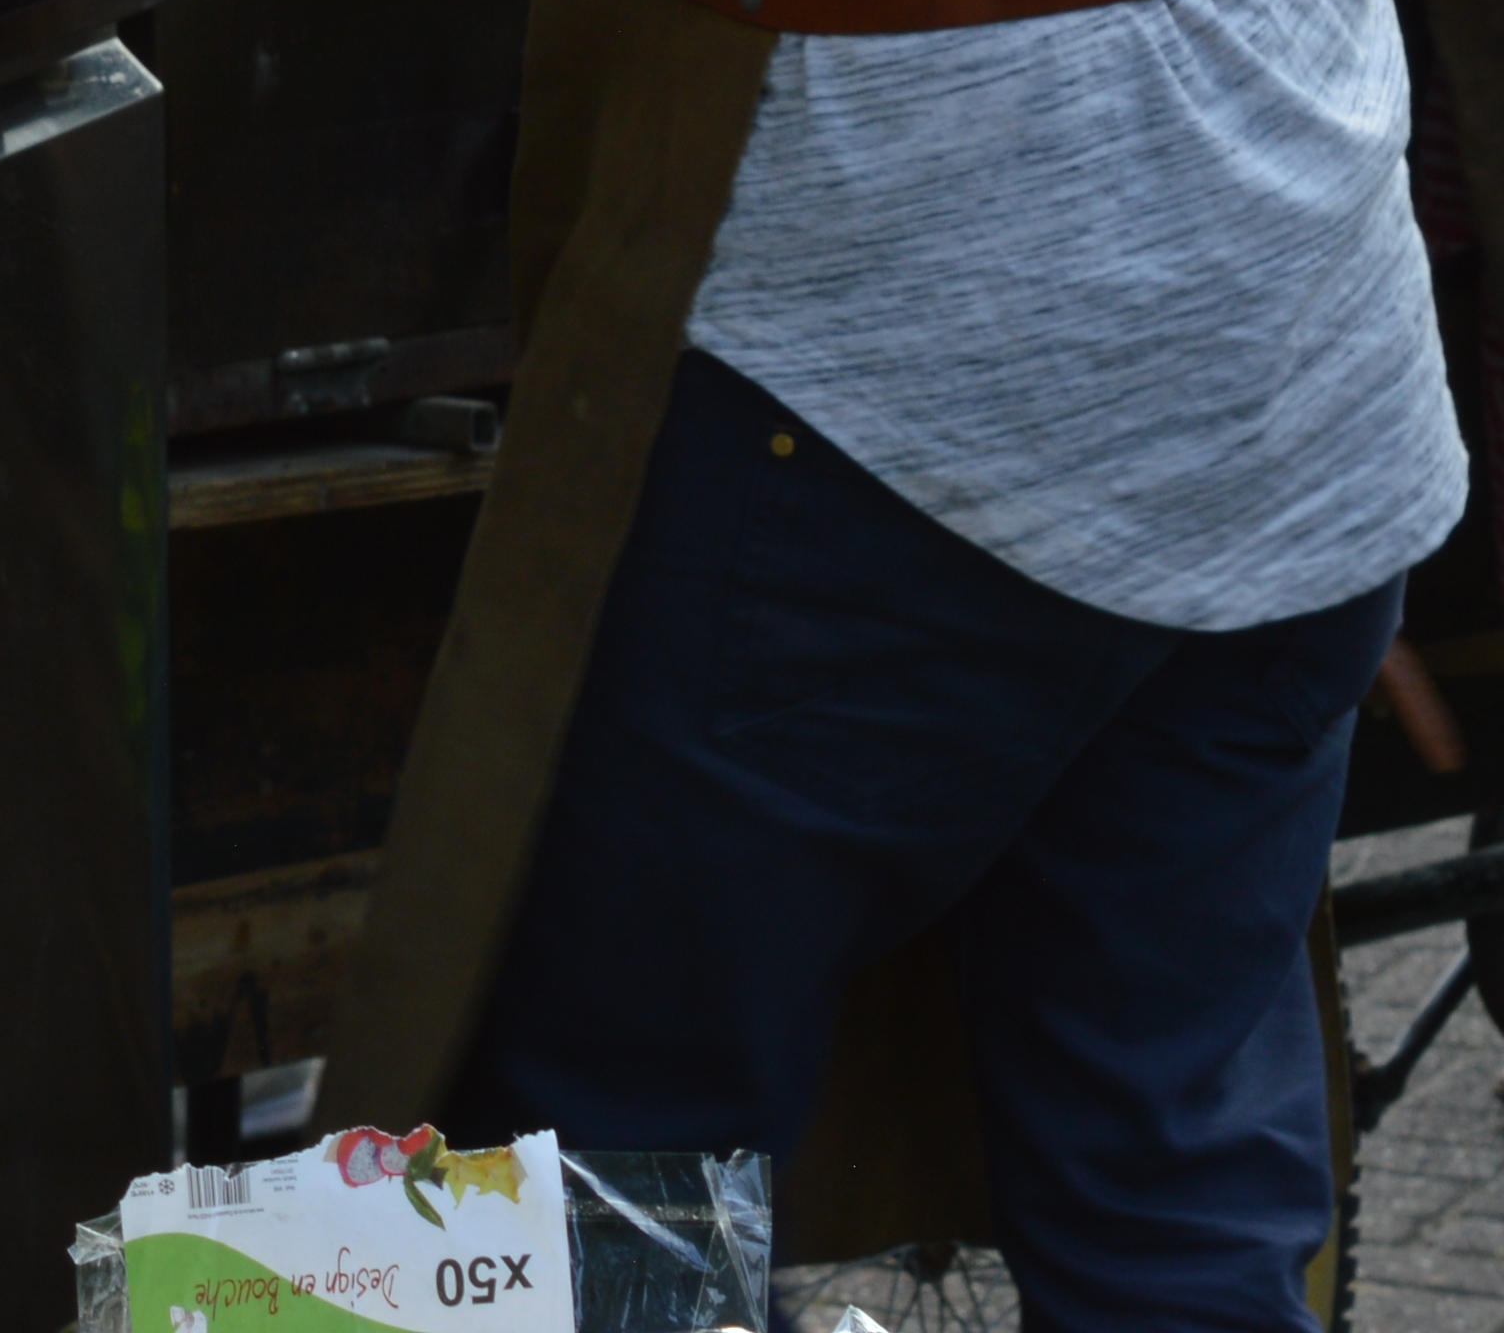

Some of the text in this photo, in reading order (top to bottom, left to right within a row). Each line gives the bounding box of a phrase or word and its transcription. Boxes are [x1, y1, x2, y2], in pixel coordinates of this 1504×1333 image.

[194, 1247, 400, 1321] Design en Bouche
[435, 1254, 533, 1308] x50
